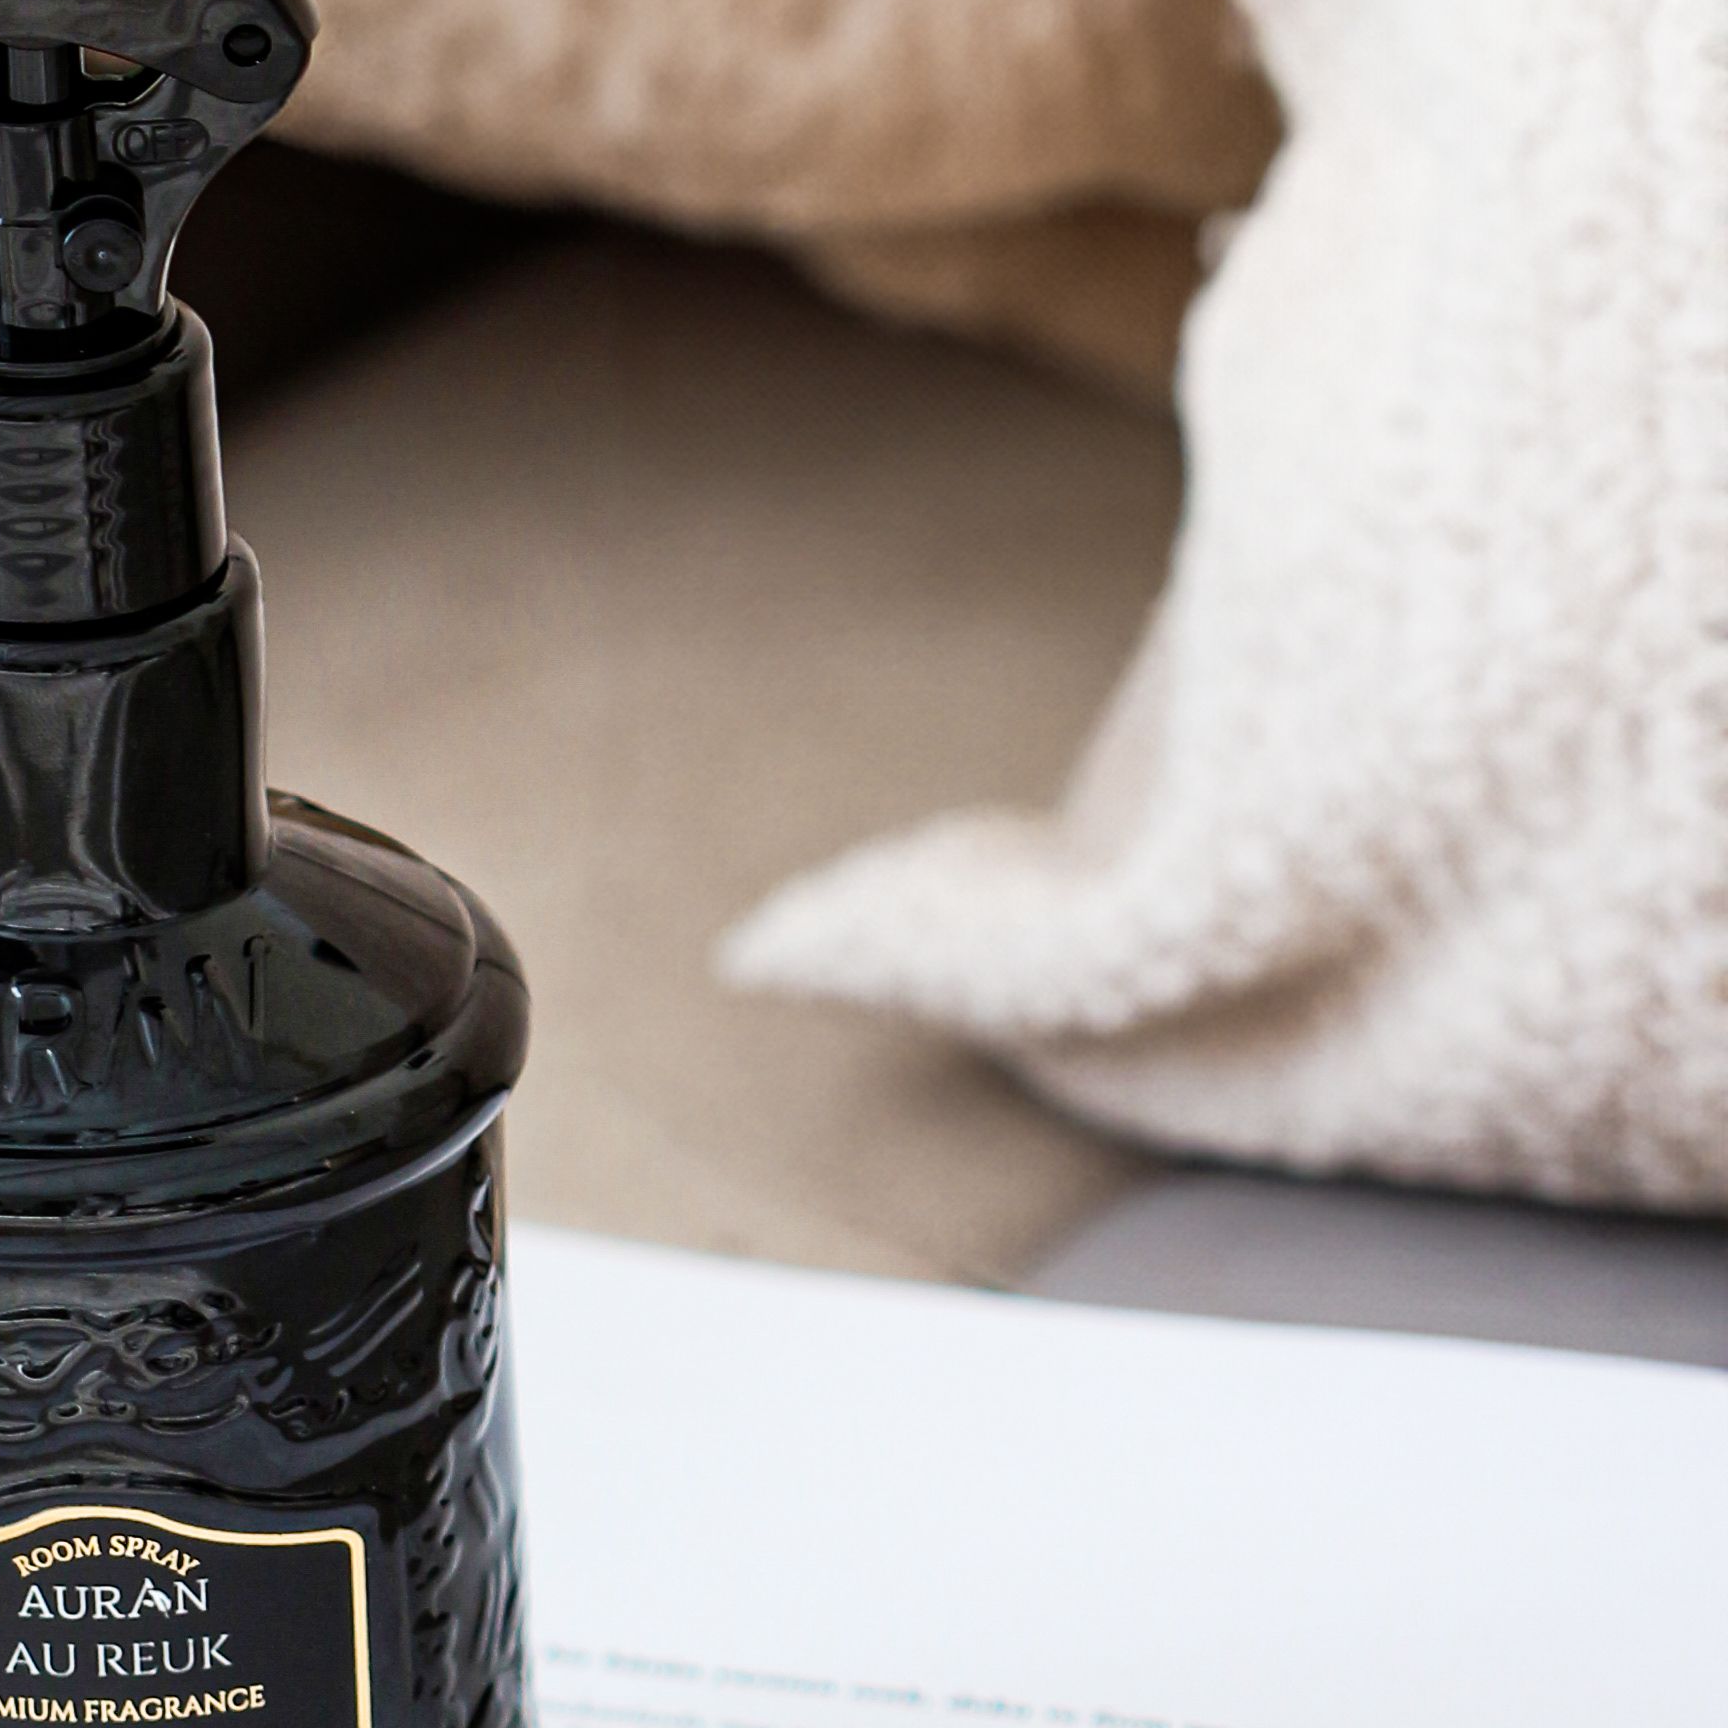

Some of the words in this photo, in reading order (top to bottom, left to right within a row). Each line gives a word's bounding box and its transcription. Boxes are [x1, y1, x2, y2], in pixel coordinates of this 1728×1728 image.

[124, 124, 191, 160] OFF
[12, 1535, 102, 1578] ROOM
[109, 1535, 200, 1576] SPRAY
[18, 1577, 209, 1619] AURAN
[5, 1641, 75, 1677] AU
[97, 1633, 233, 1677] REUK
[83, 1684, 266, 1724] FRAGRANCE
